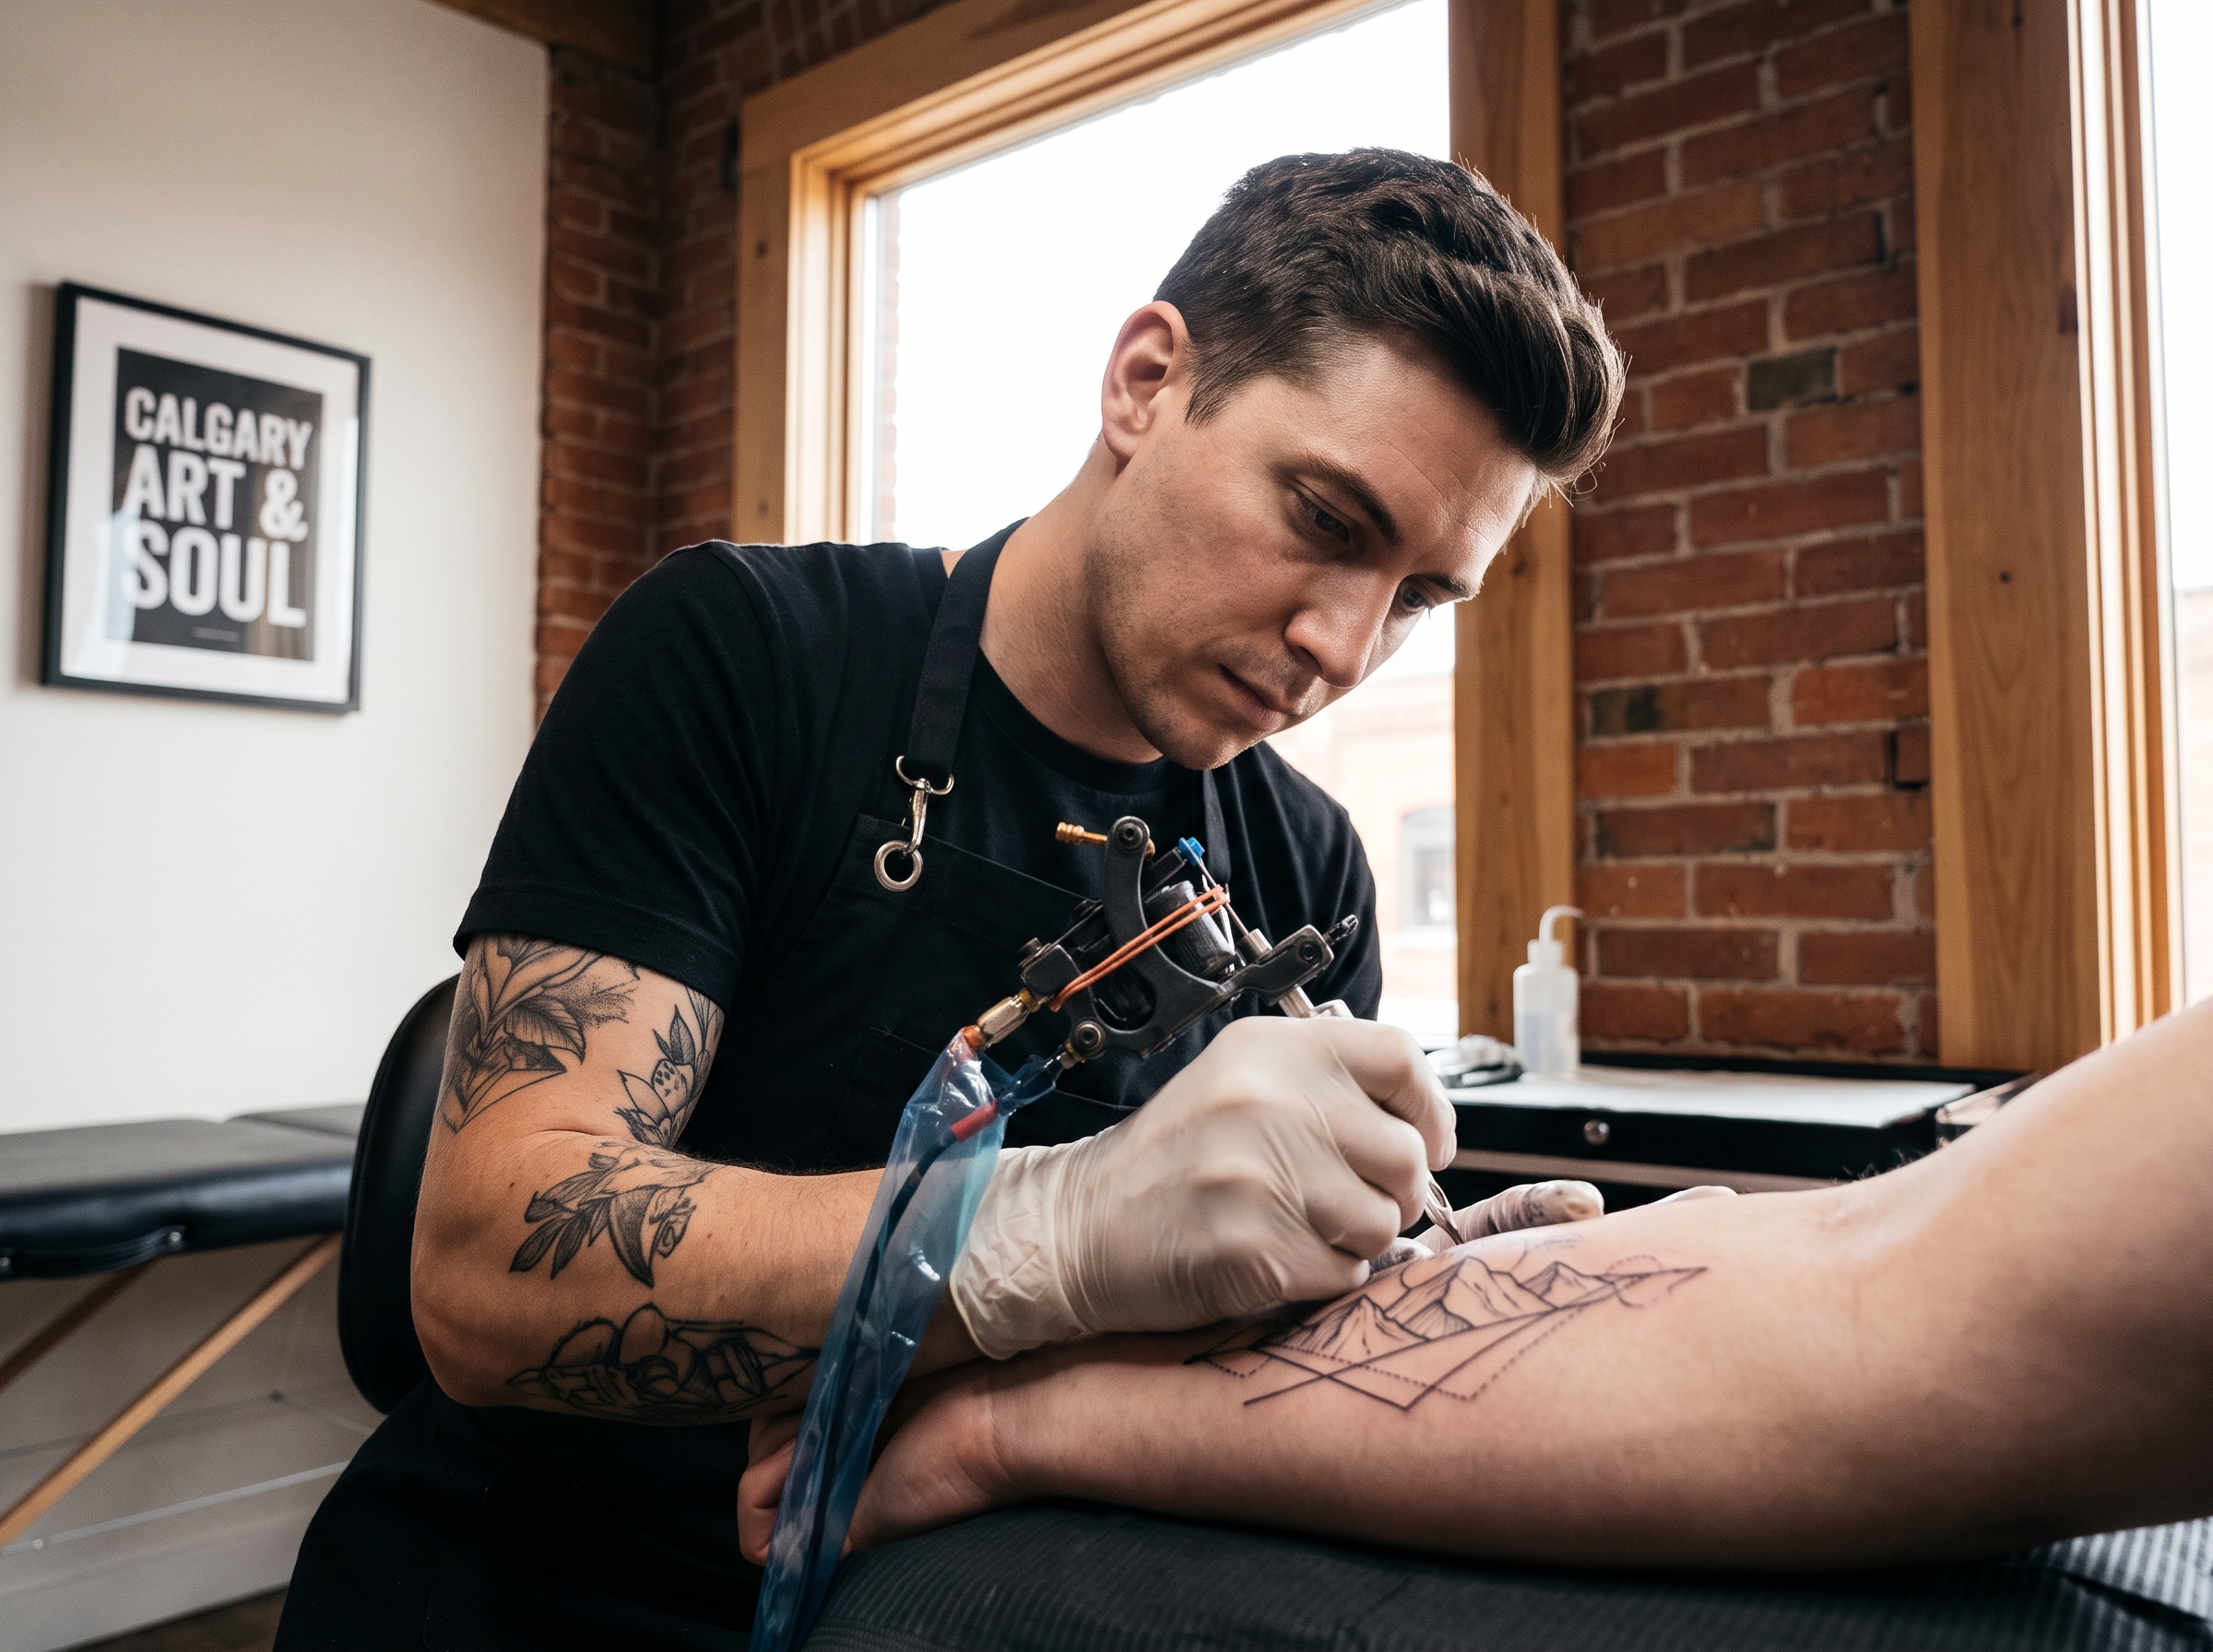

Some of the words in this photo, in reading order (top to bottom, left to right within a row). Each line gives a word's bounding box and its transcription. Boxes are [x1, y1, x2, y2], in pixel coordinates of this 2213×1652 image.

[124, 387, 313, 469] CALGARY
[121, 443, 246, 529] ART
[259, 468, 308, 542] &
[121, 520, 306, 629] SOUL
